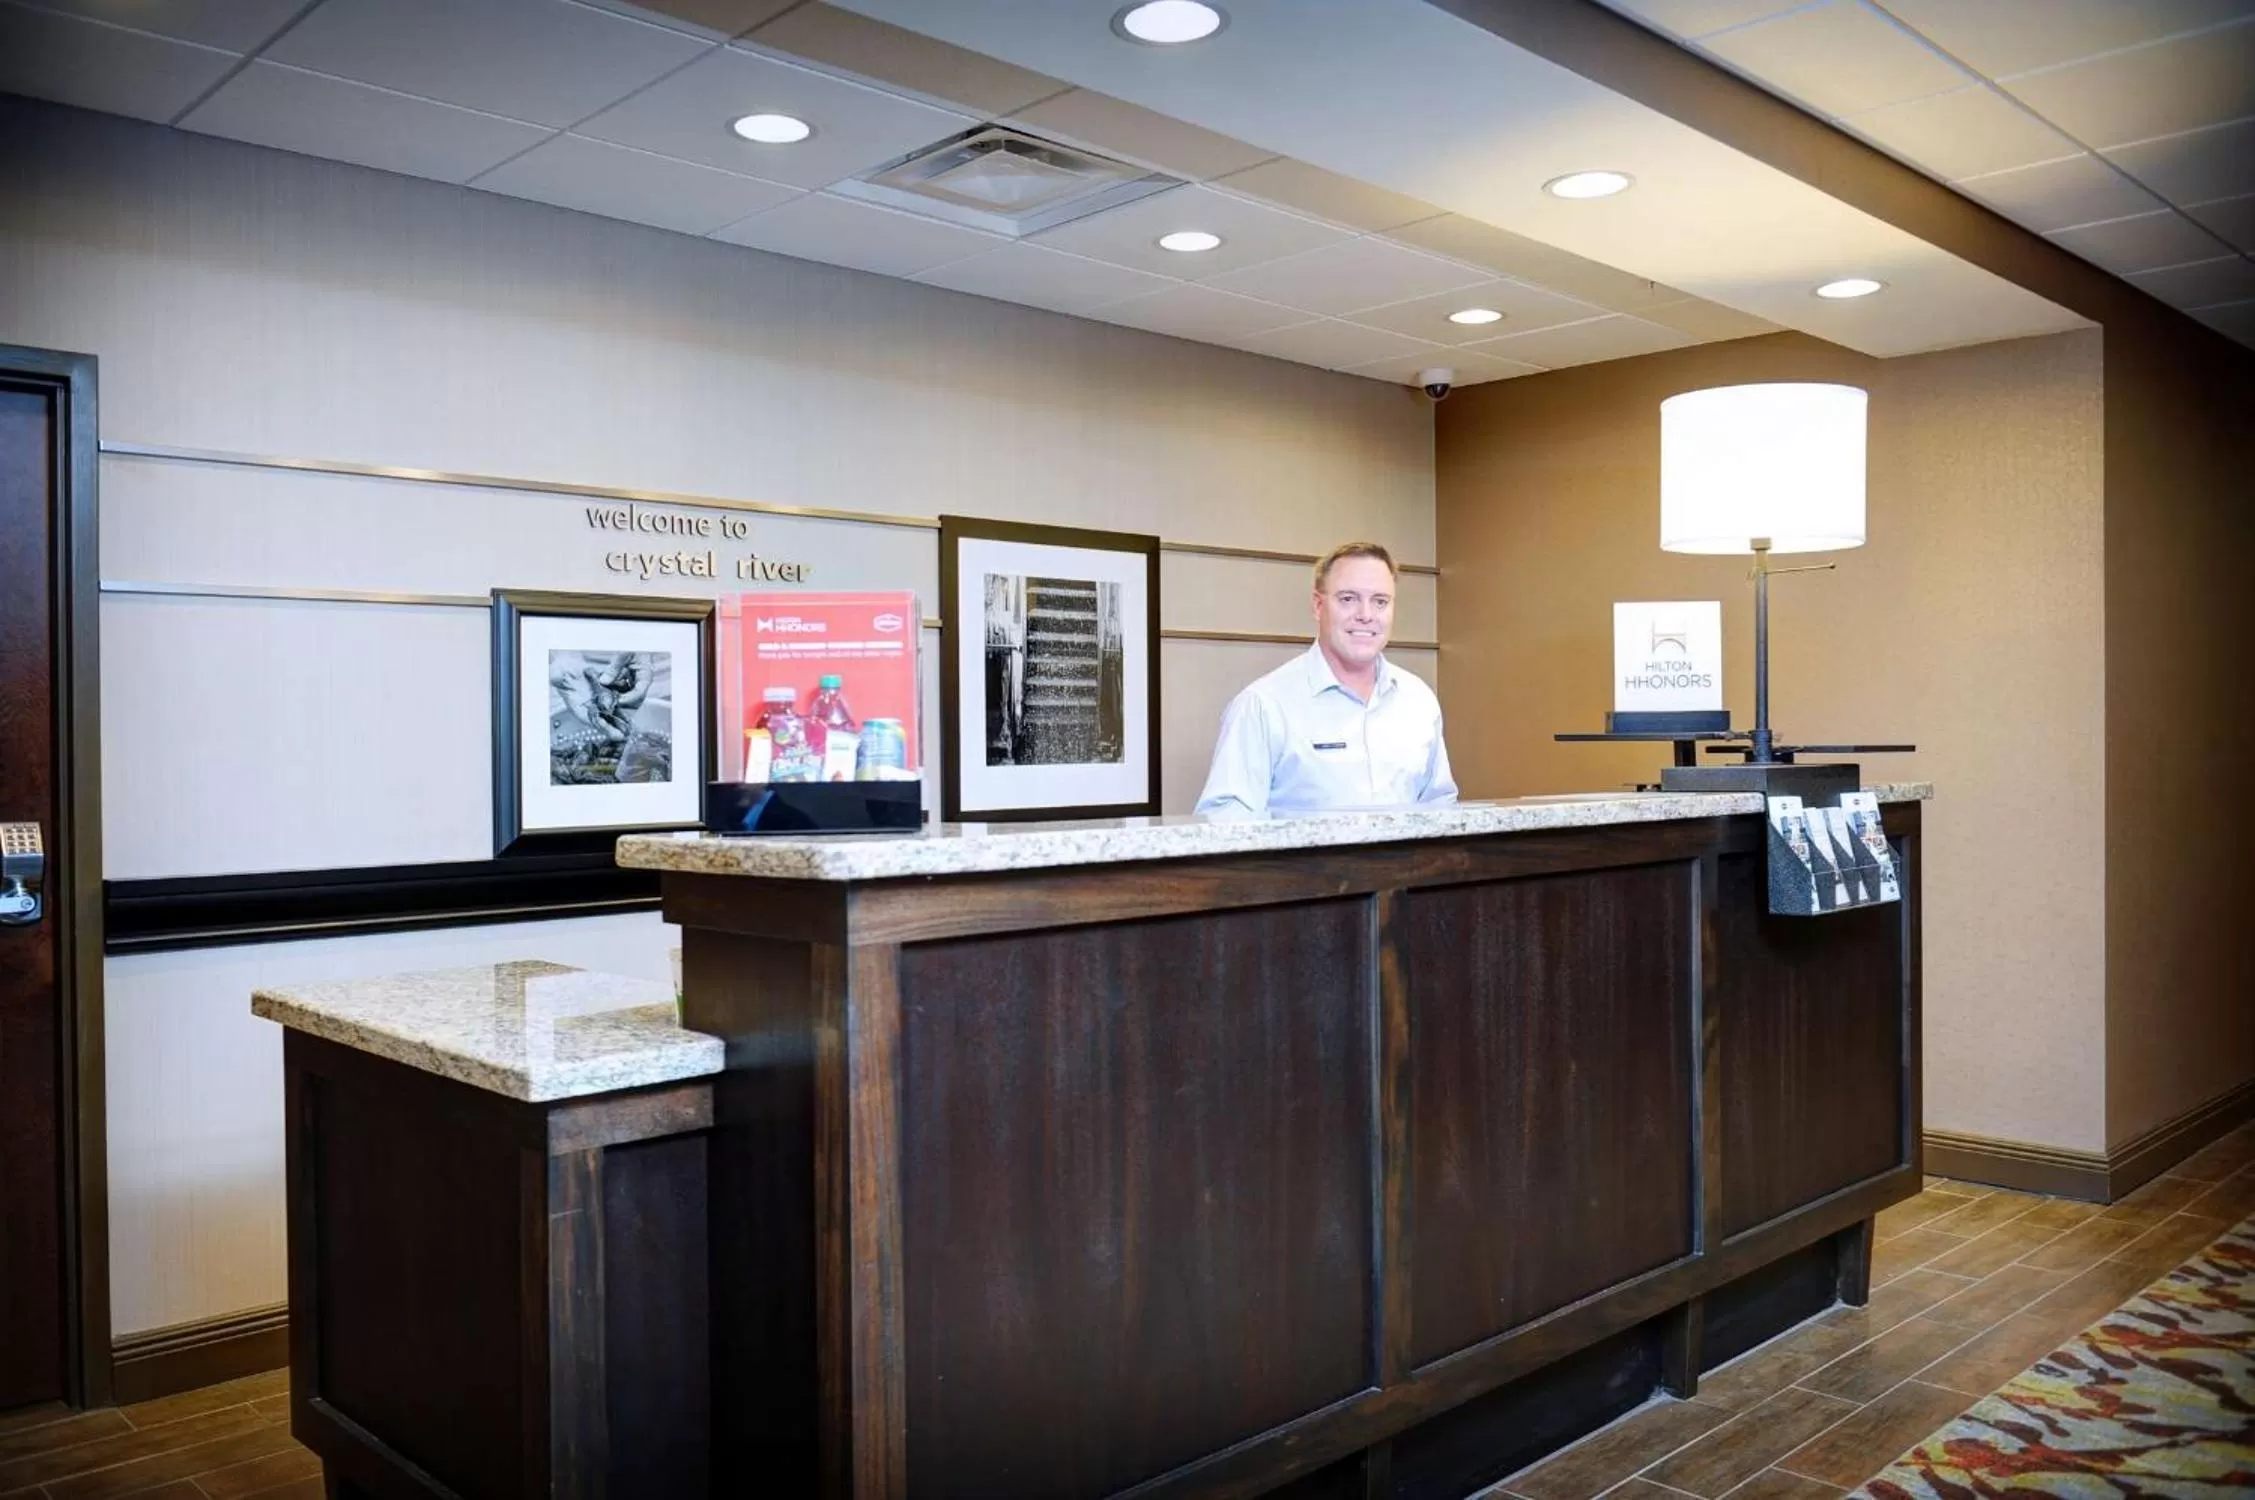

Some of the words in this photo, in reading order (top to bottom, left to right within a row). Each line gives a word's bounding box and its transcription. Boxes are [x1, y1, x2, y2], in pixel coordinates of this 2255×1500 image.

[586, 502, 713, 538] welcome
[719, 514, 749, 540] to
[605, 550, 717, 581] crystal
[736, 552, 812, 583] river
[1644, 660, 1692, 673] HILTON
[1624, 674, 1712, 690] HHONORS
